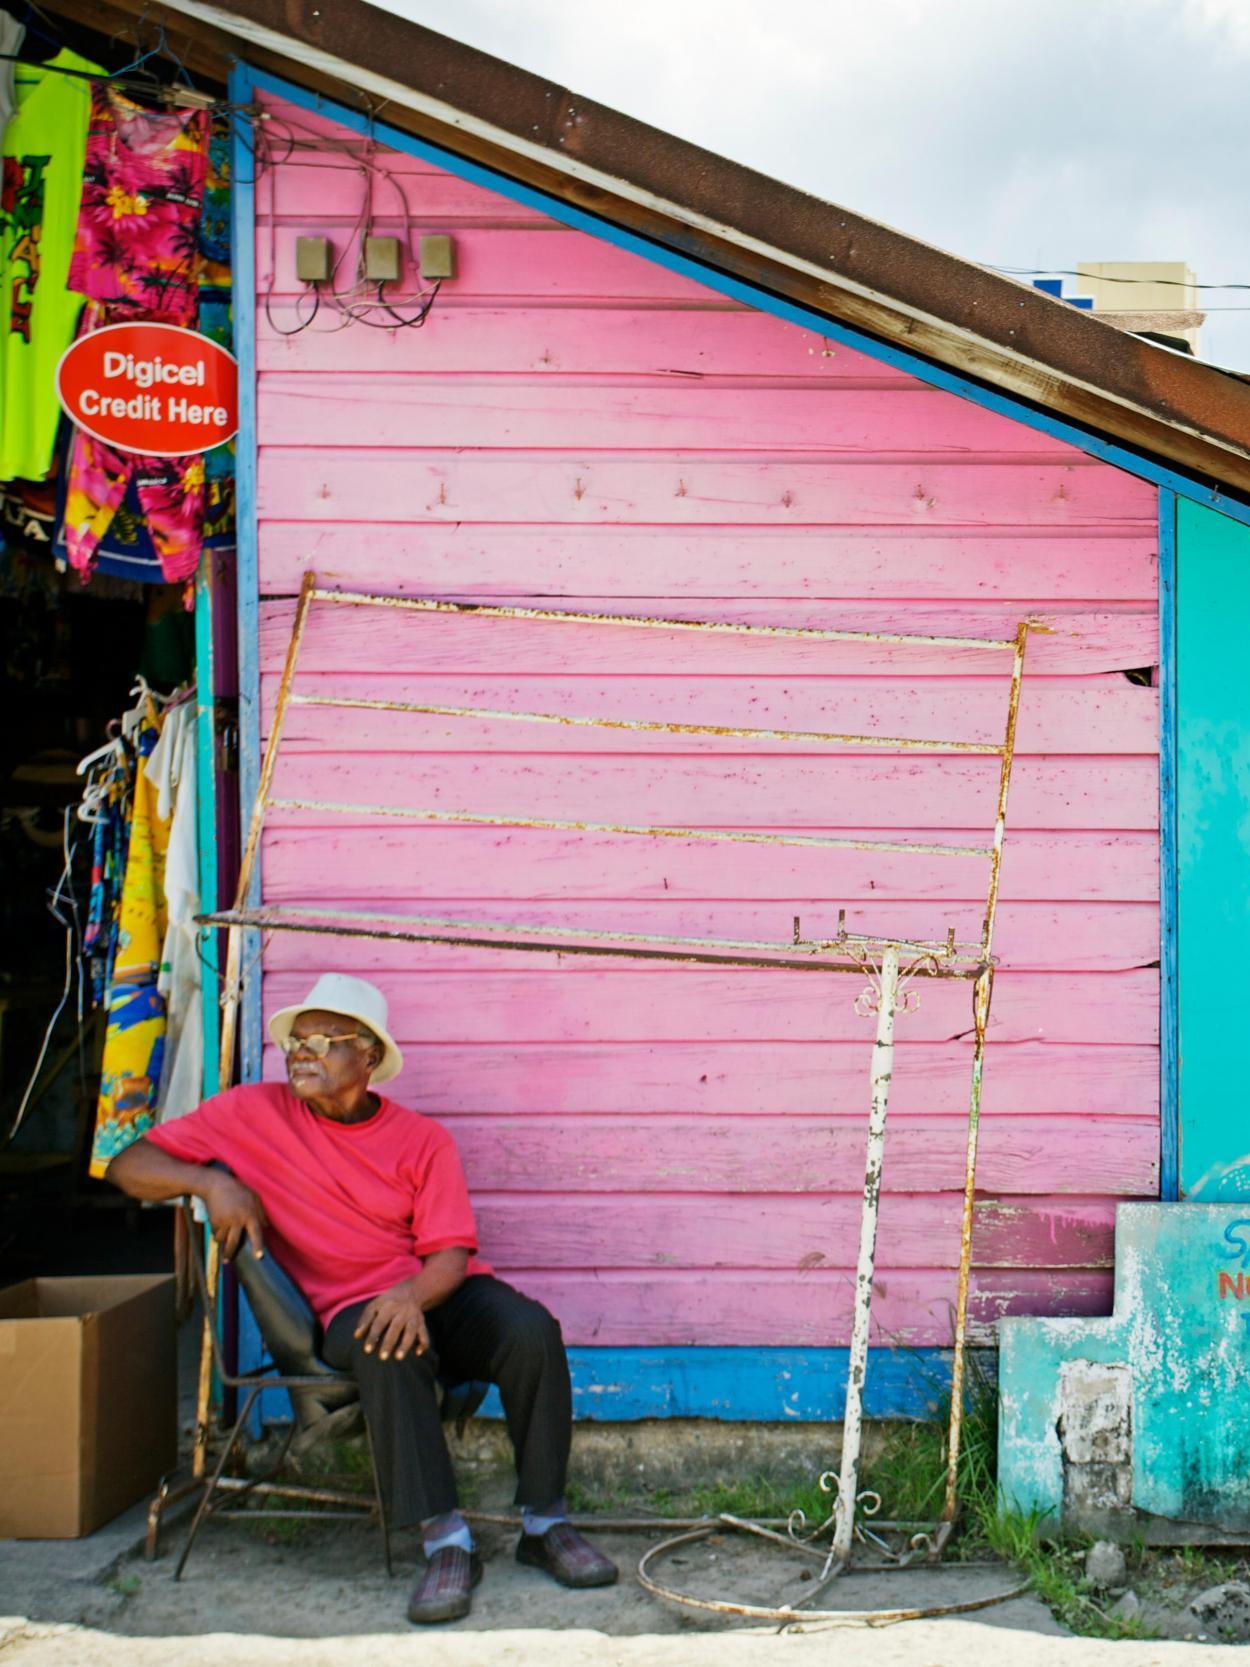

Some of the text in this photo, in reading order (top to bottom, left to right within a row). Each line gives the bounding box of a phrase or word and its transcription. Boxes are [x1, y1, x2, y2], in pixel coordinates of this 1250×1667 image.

[103, 351, 206, 388] Digicel
[79, 389, 228, 426] Credit Here
